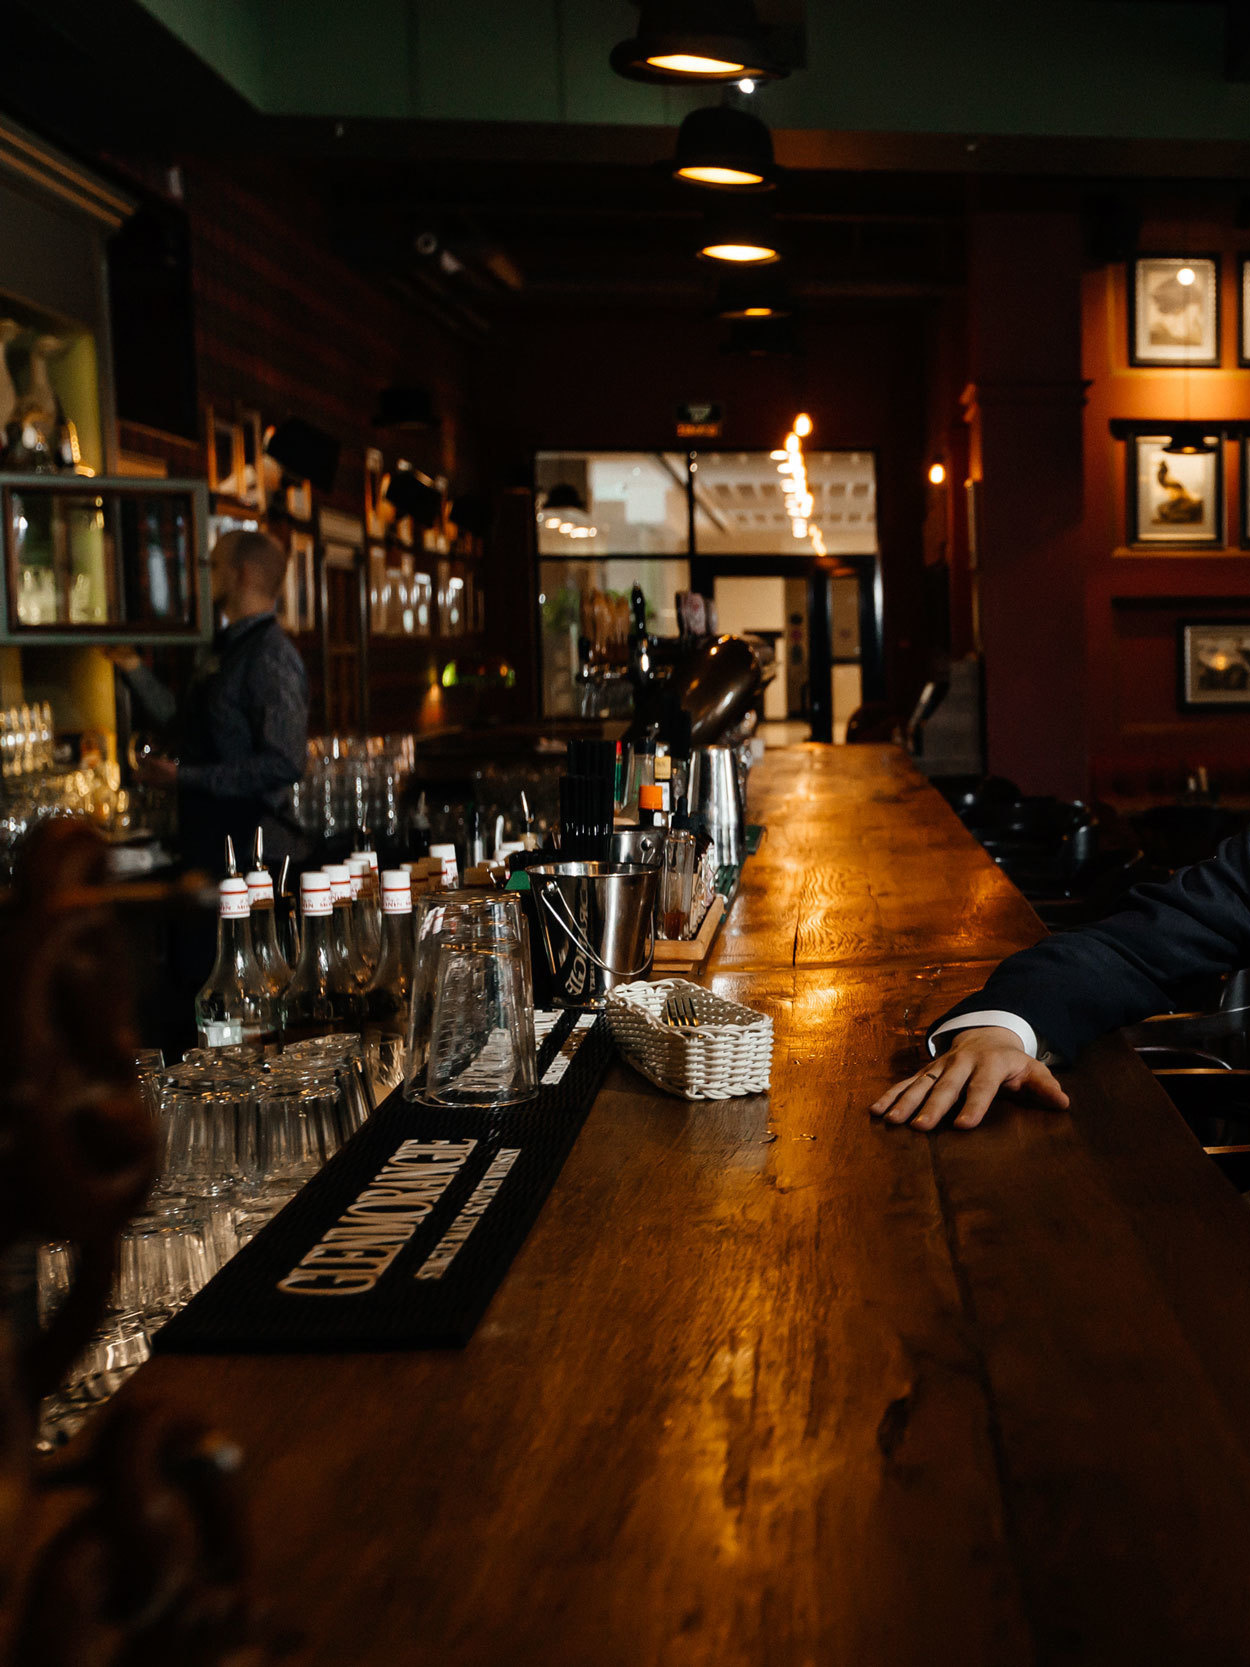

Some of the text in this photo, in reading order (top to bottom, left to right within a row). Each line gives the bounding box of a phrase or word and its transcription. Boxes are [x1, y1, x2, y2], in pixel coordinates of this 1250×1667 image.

[460, 1179, 504, 1215] SCOTCH
[276, 1138, 478, 1296] GLENMORANGIE
[441, 1215, 480, 1242] MALT
